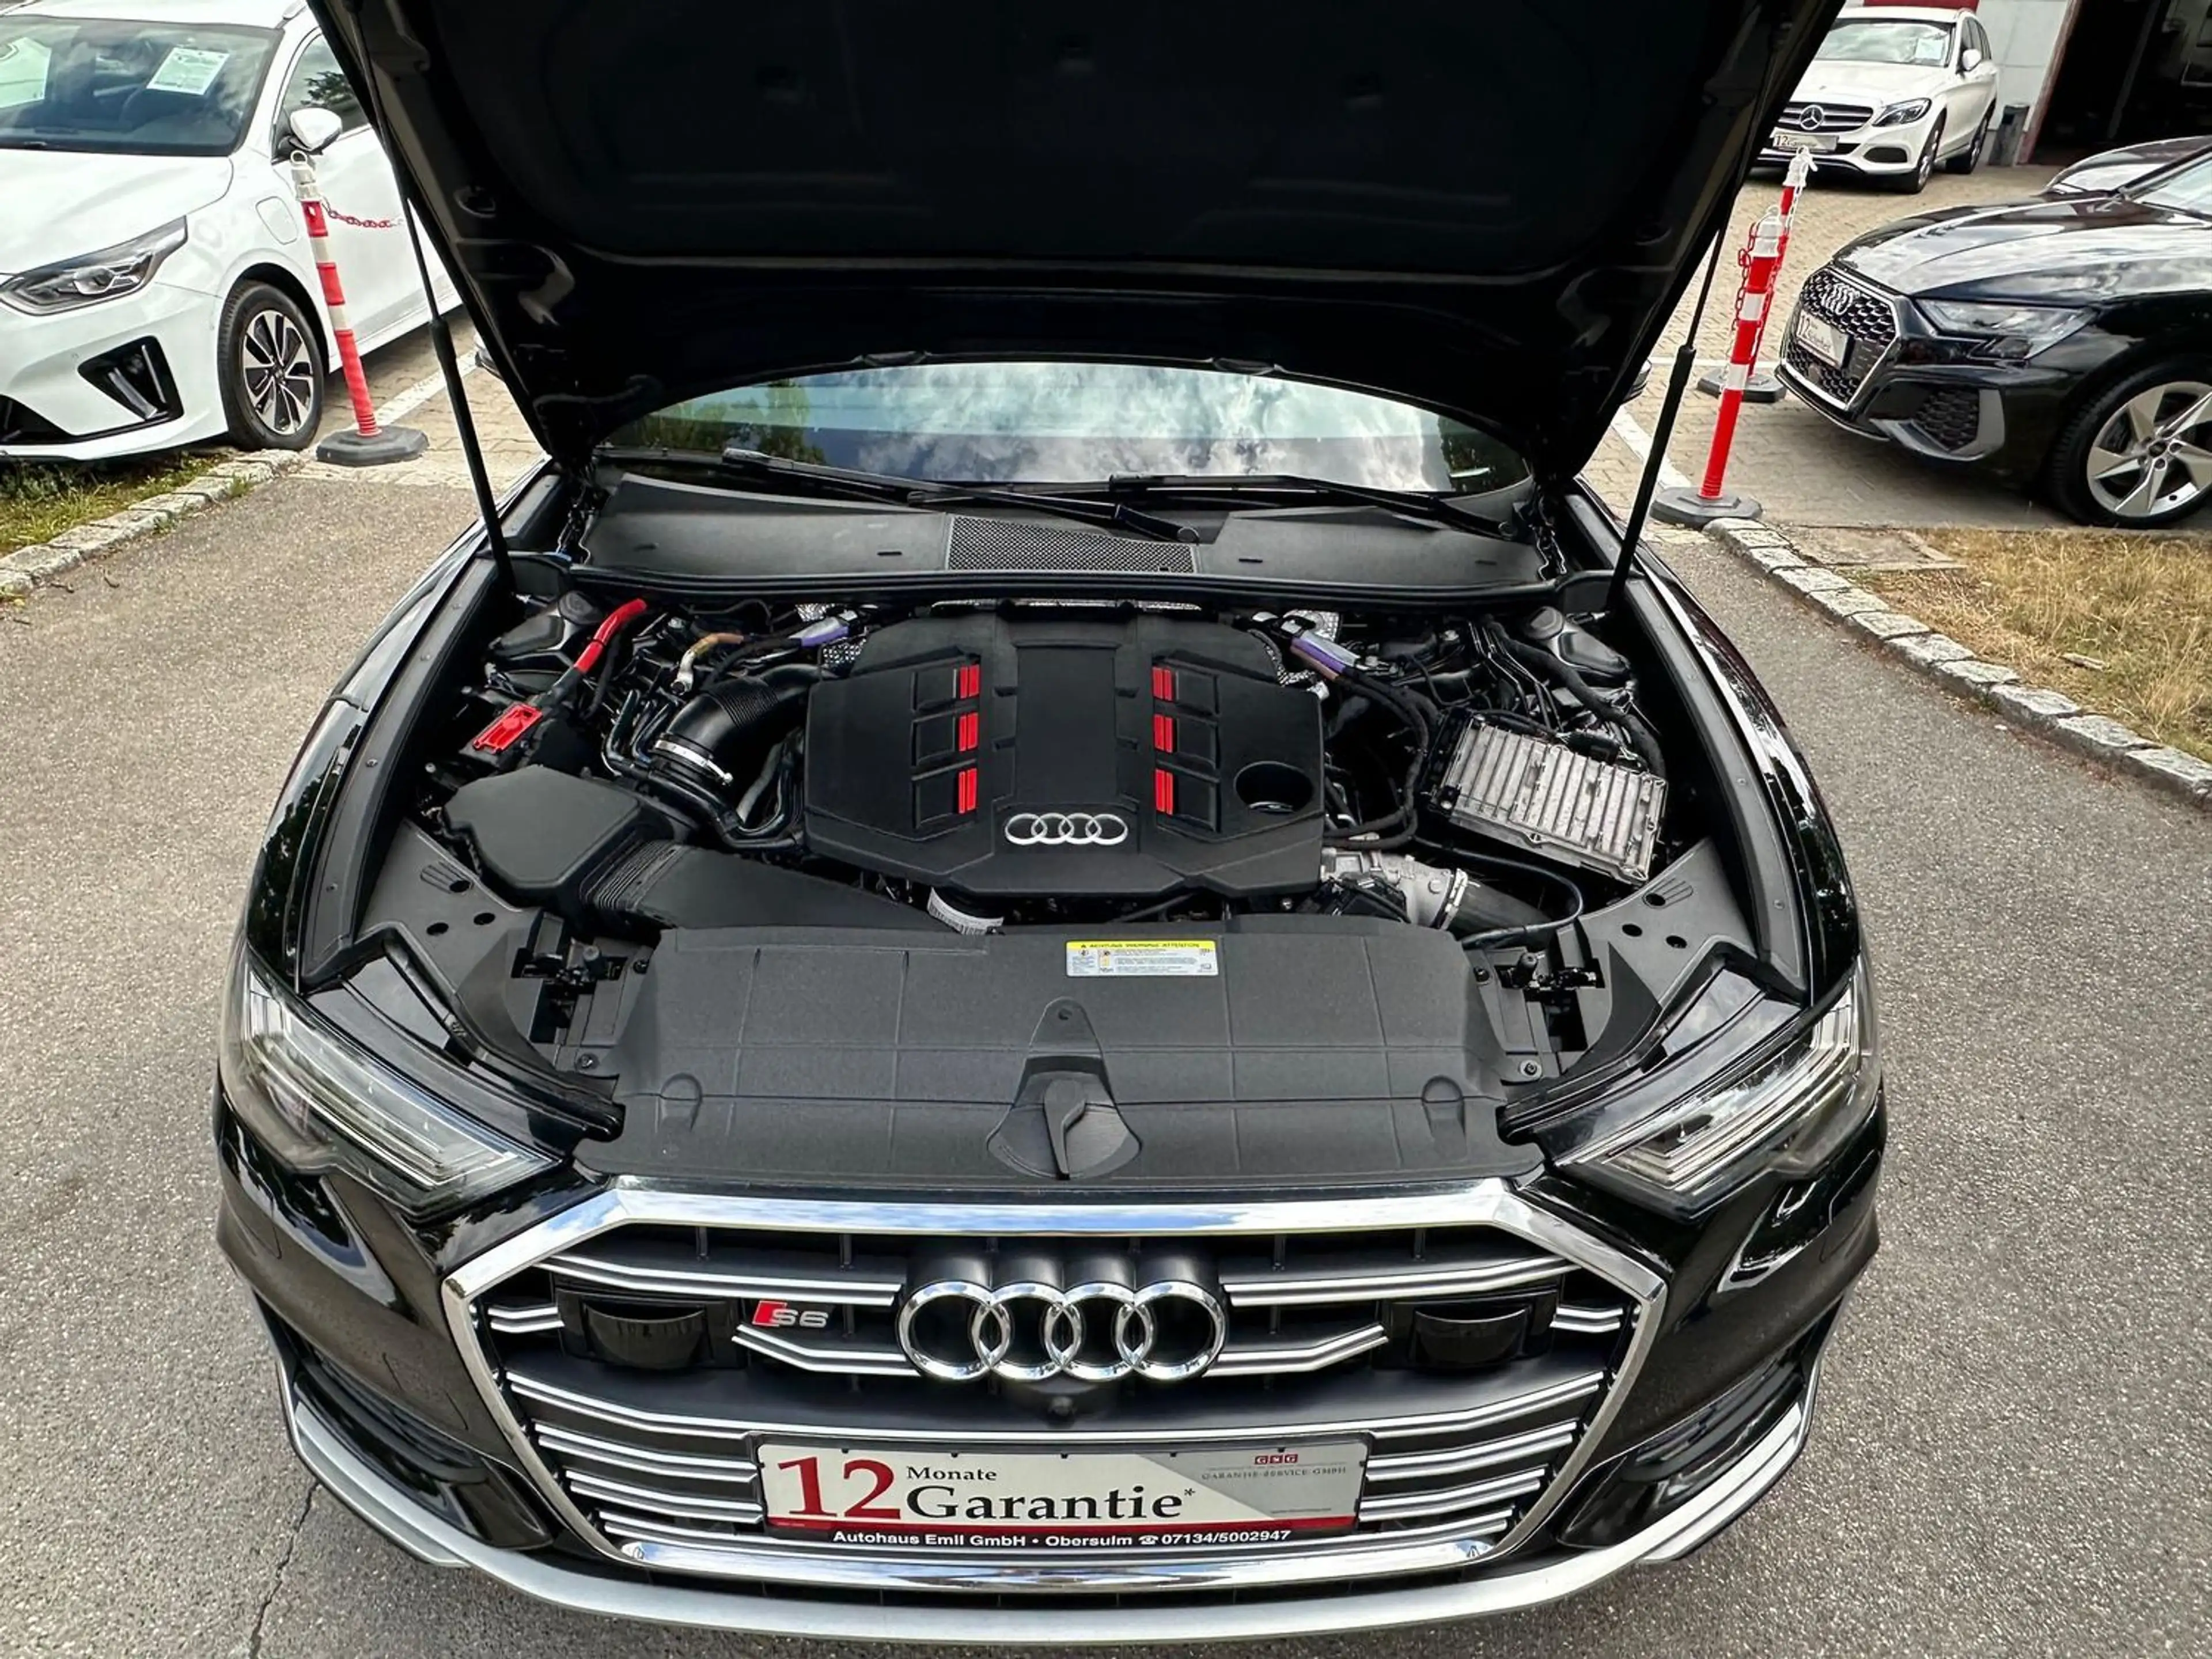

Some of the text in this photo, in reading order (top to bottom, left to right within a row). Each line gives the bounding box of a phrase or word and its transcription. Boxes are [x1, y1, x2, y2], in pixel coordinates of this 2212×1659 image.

[769, 1308, 829, 1328] S6
[778, 1456, 997, 1520] 12 Monate
[833, 1530, 1291, 1547] Autohaus Emil GmbH Obersulm 07134/5002947
